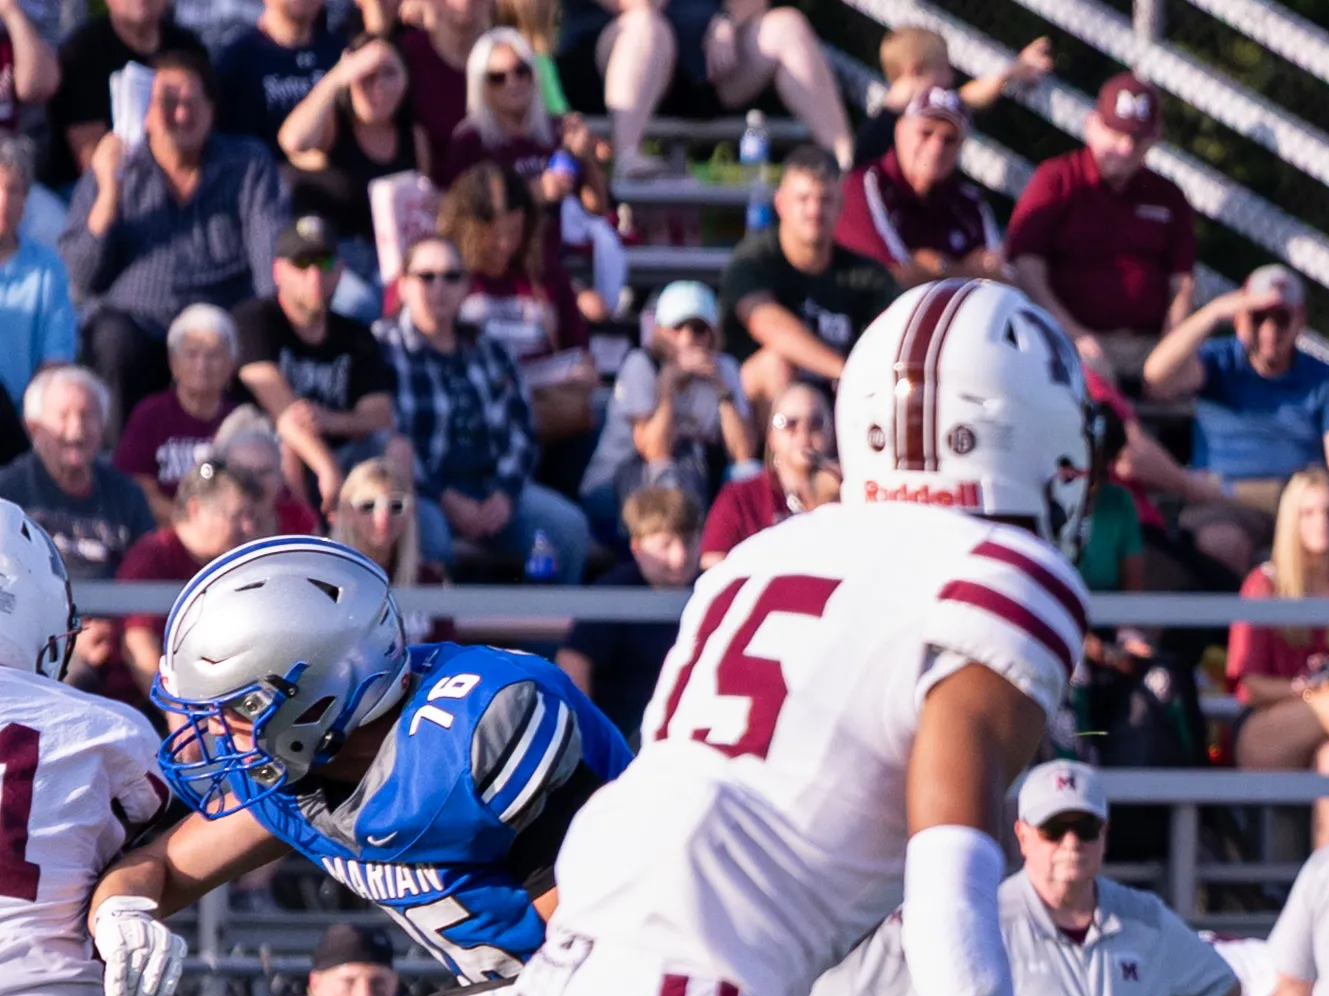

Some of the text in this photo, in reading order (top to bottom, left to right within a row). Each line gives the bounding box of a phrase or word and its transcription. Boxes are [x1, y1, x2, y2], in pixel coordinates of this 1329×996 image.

[865, 481, 980, 507] Riddell
[655, 574, 843, 763] 15
[408, 673, 481, 737] 76
[321, 856, 444, 901] MARIAN
